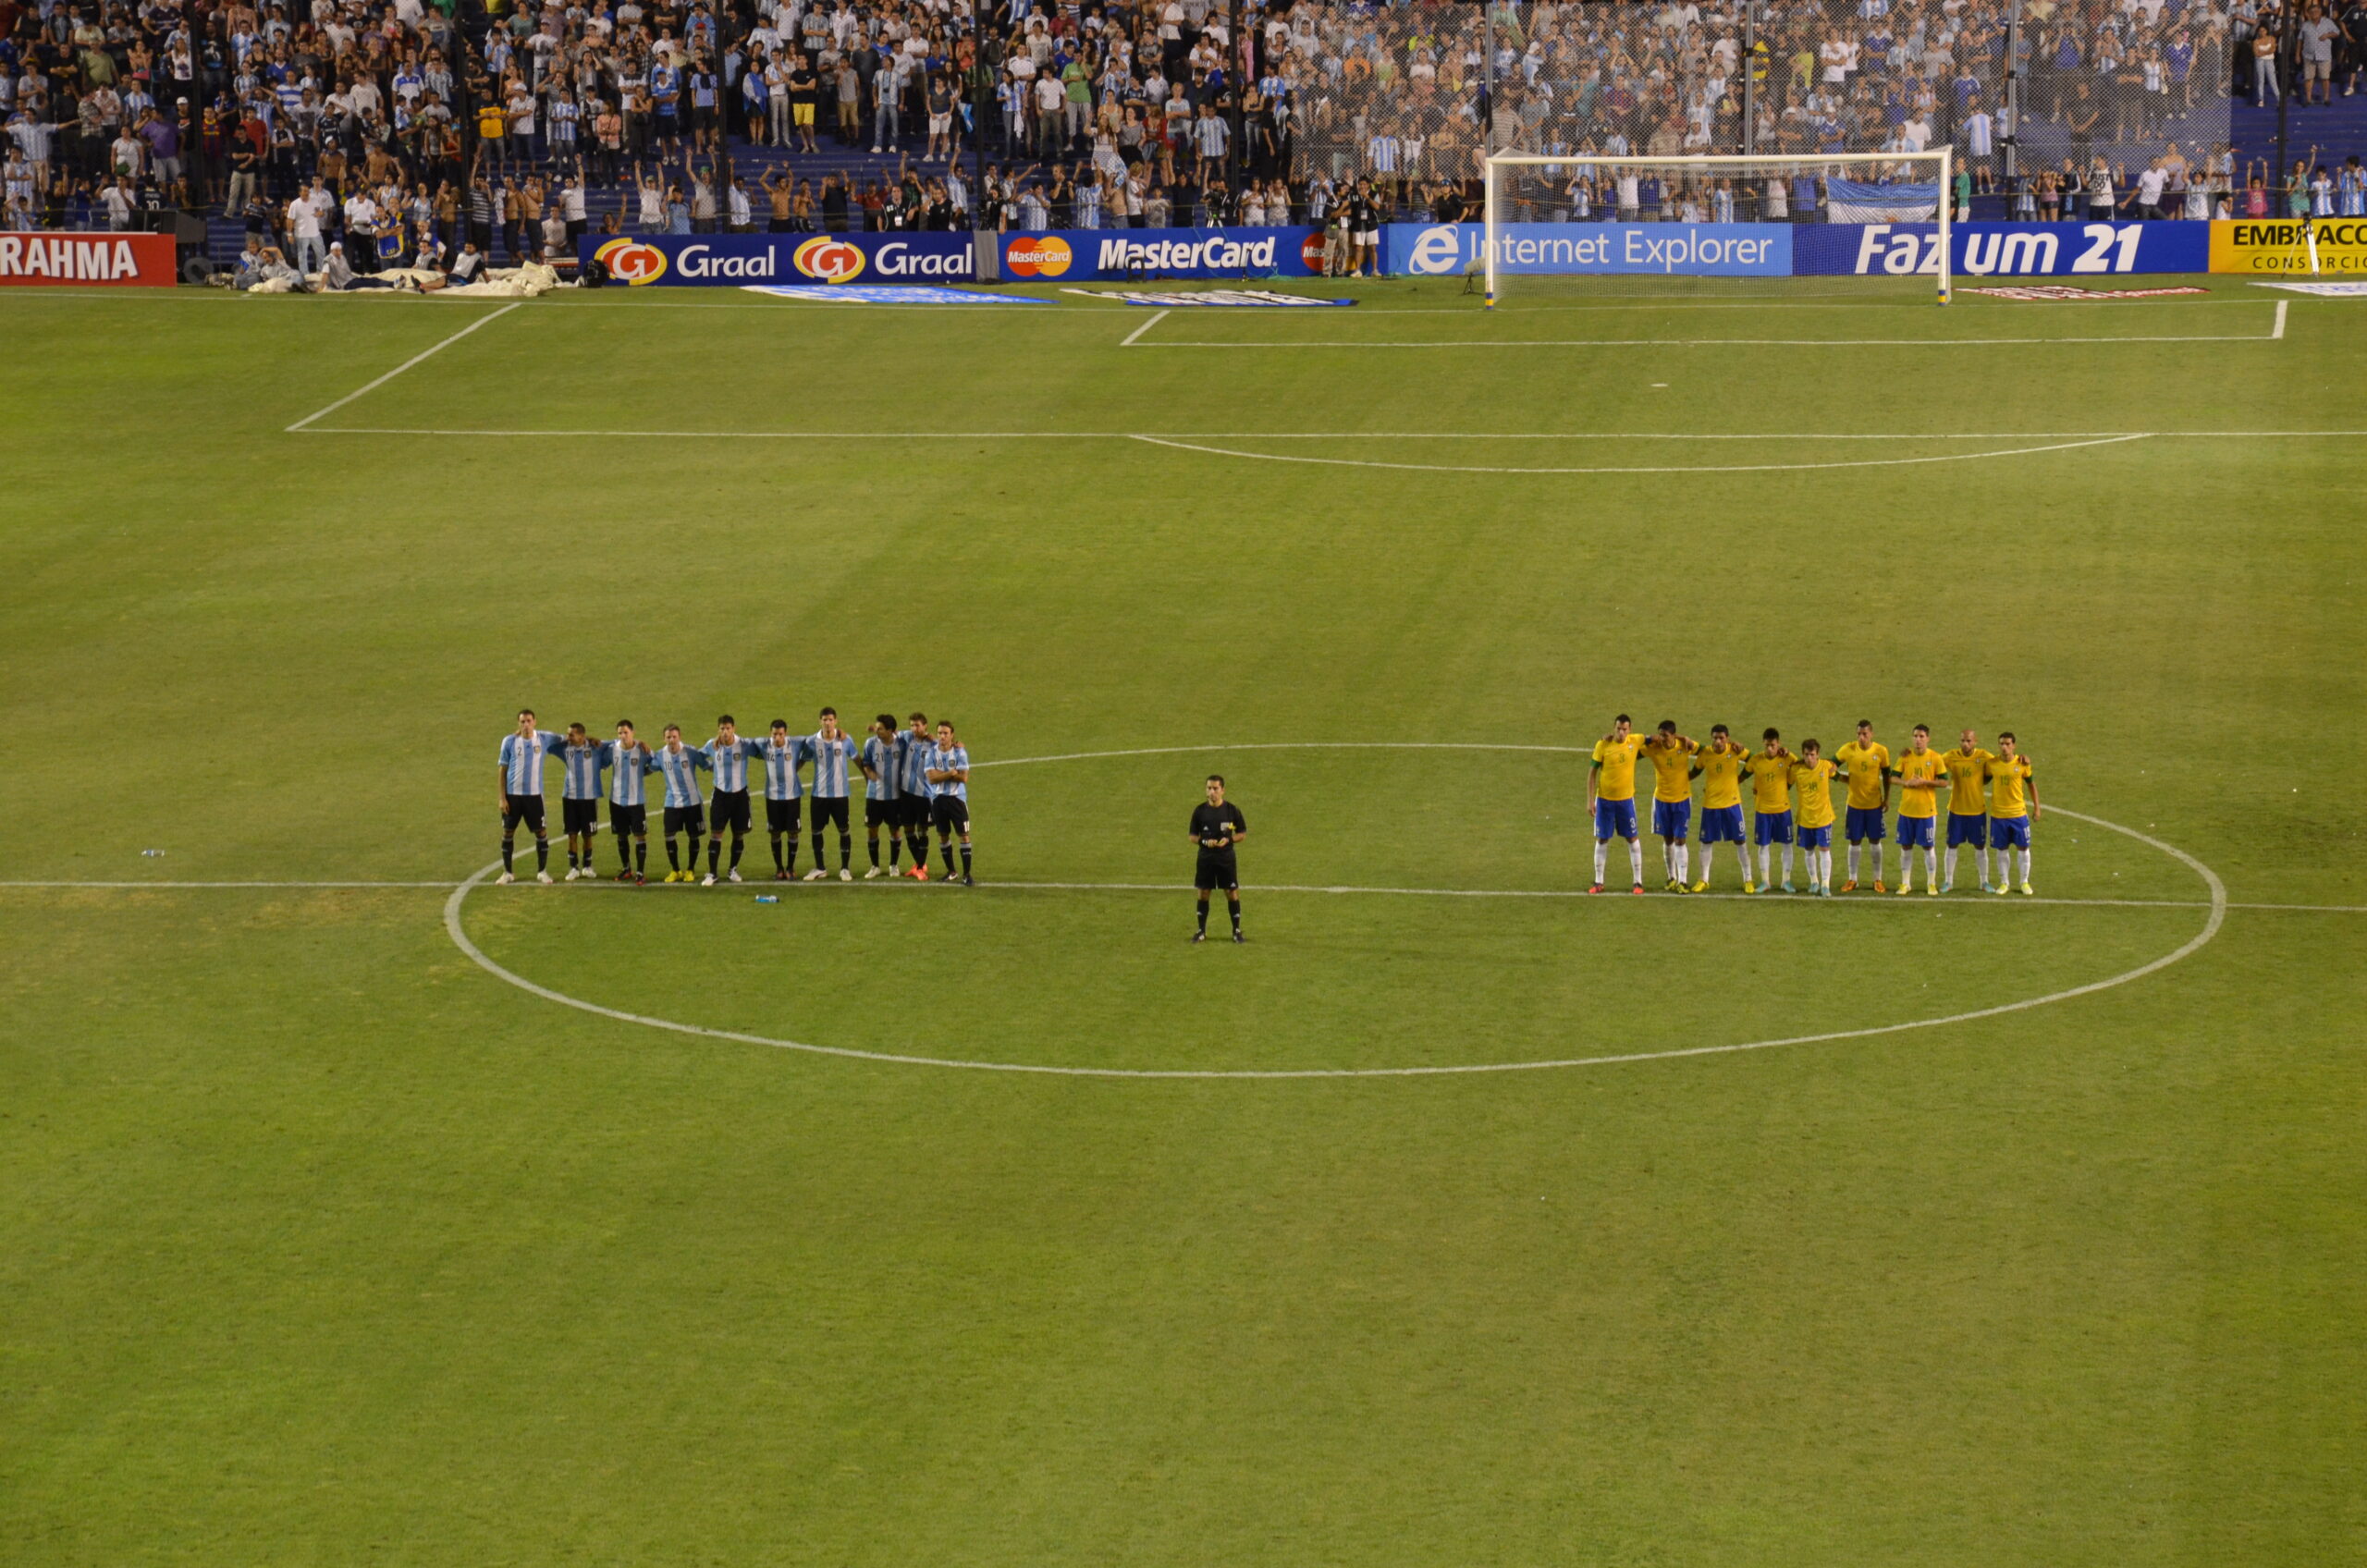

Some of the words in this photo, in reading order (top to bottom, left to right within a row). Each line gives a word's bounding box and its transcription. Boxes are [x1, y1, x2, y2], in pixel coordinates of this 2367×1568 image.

[146, 200, 160, 212] 10
[1098, 237, 1276, 270] MasterCard
[1471, 231, 1610, 264] Internet
[1625, 228, 1773, 274] Explorer
[1855, 225, 1953, 275] Faz
[1964, 232, 2059, 274] um
[2072, 224, 2143, 273] 21
[0, 236, 138, 280] RAHMA
[677, 245, 775, 277] Graal
[876, 242, 974, 276] Graal
[1008, 251, 1071, 263] MasterCard
[517, 746, 522, 756] 2
[876, 753, 884, 762] 21
[665, 761, 673, 771] 10
[1630, 817, 1636, 829] 3
[1926, 828, 1935, 839] 10
